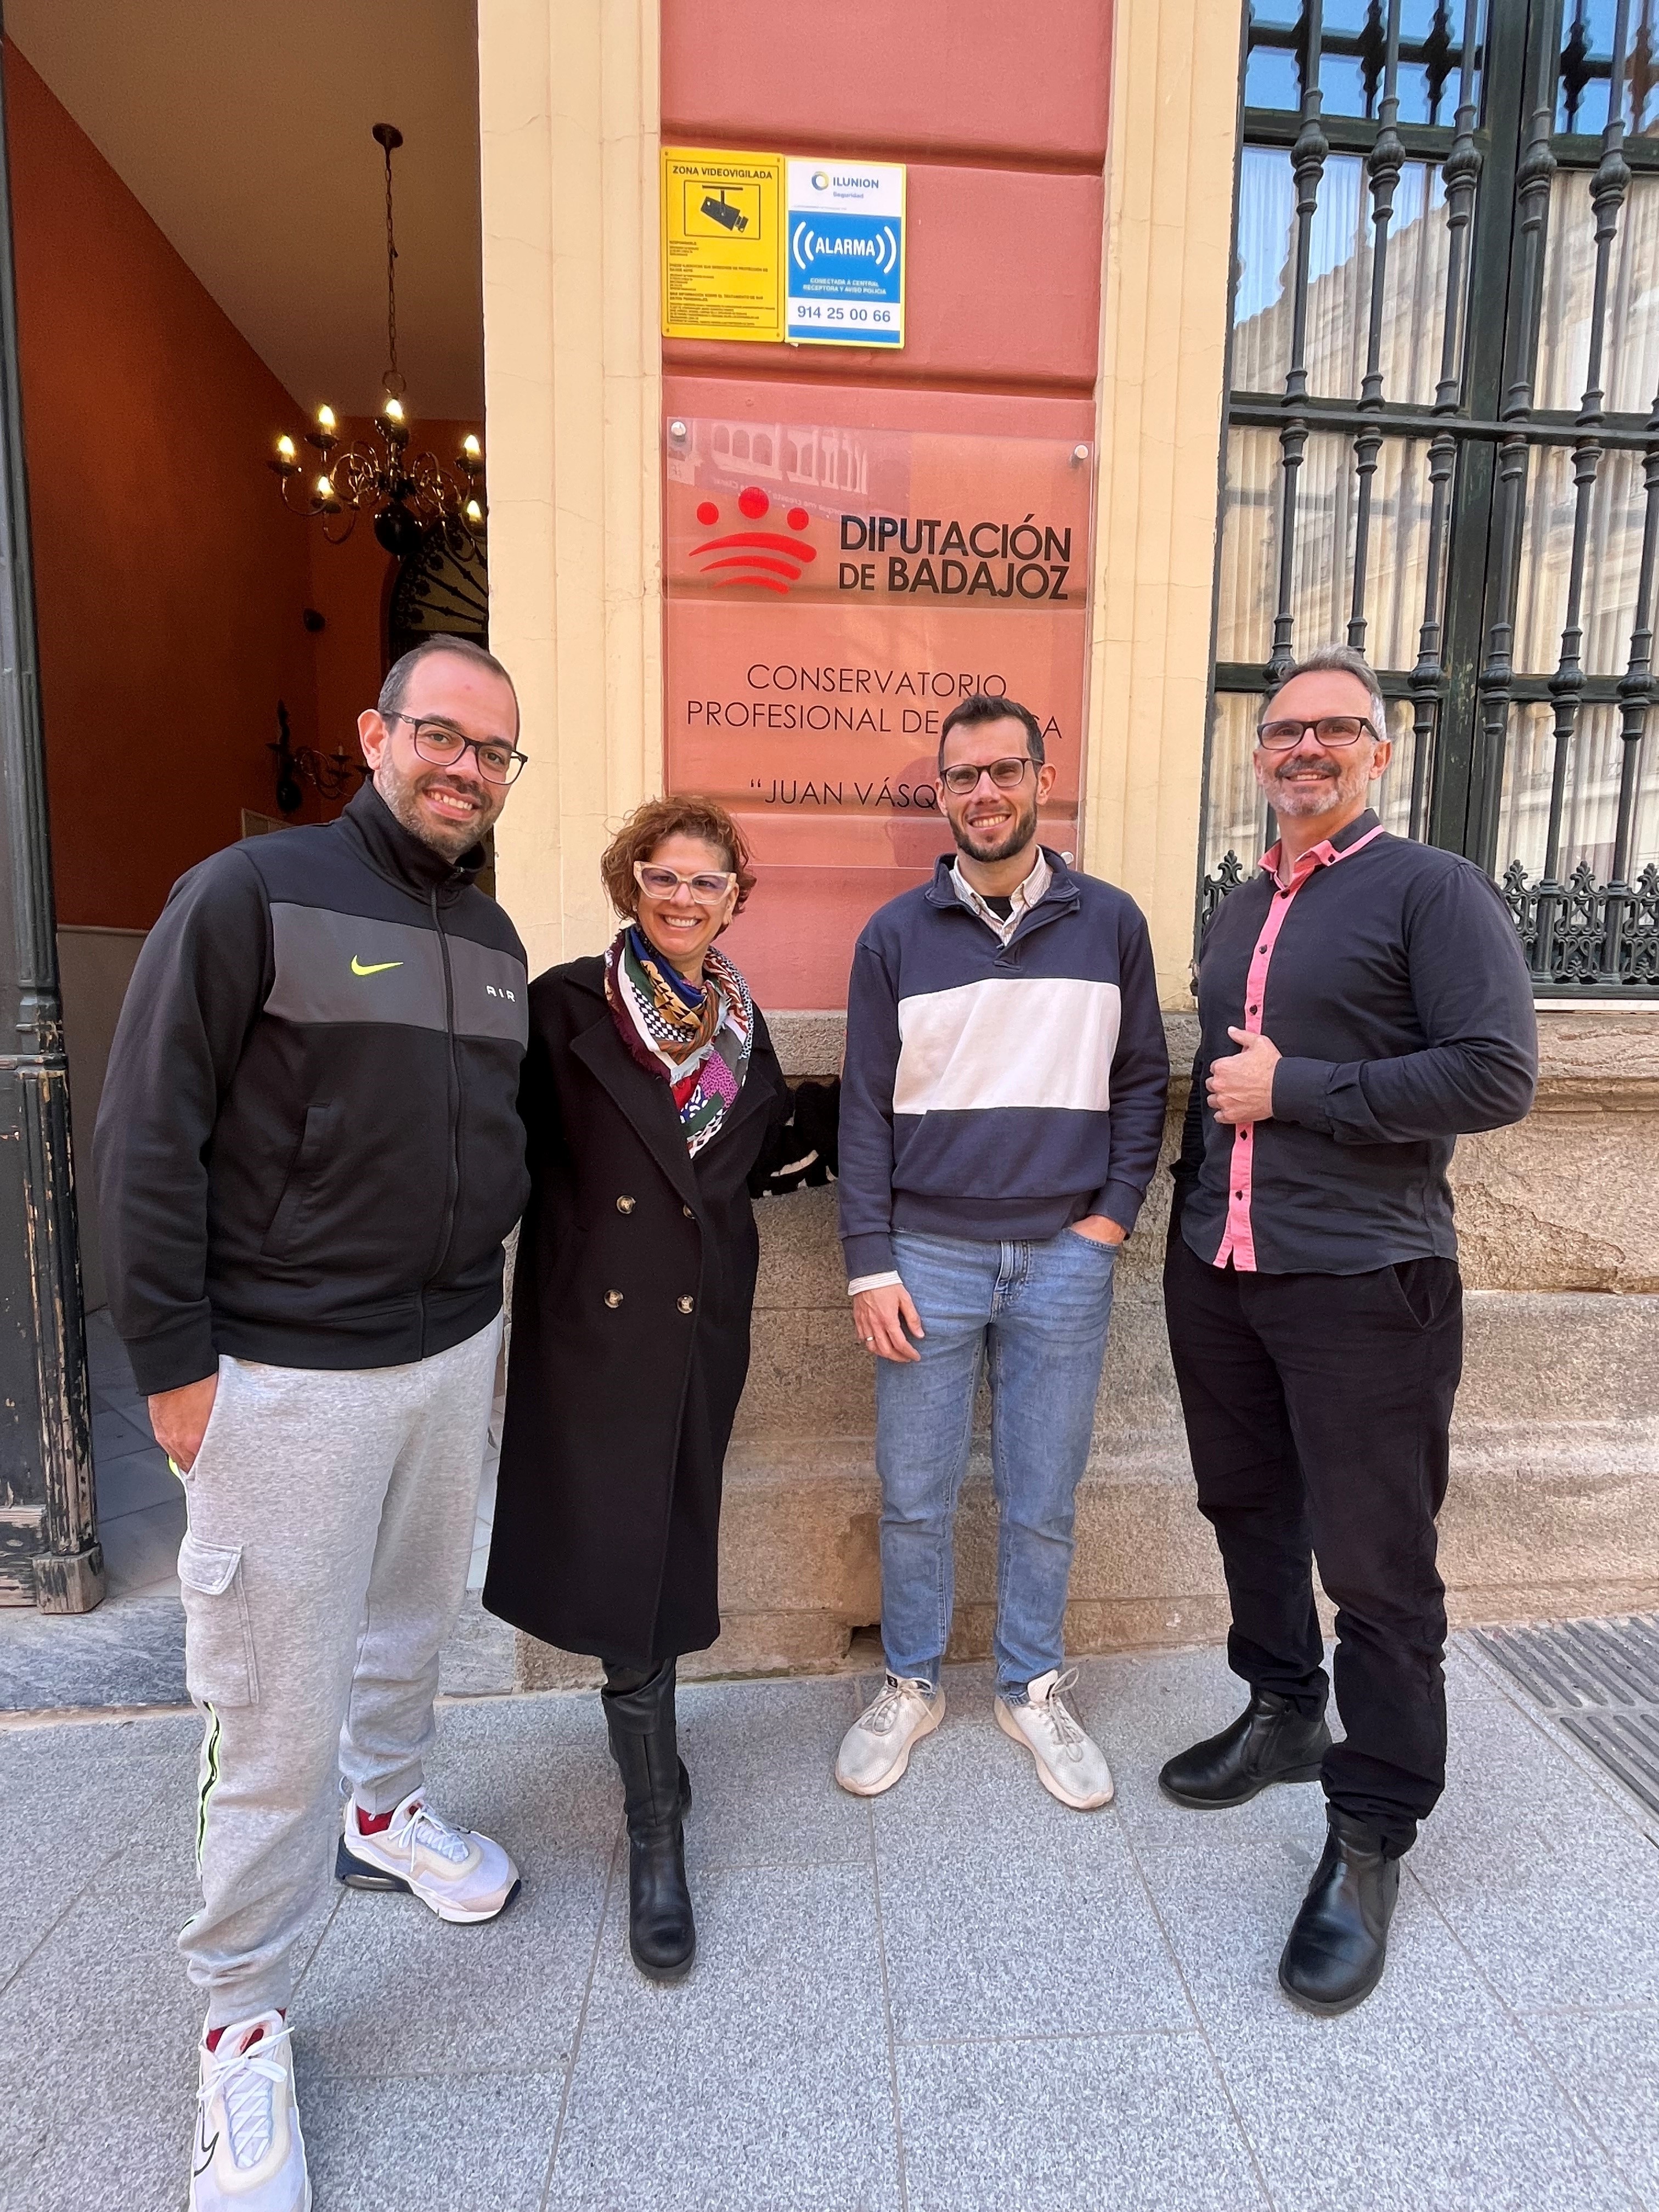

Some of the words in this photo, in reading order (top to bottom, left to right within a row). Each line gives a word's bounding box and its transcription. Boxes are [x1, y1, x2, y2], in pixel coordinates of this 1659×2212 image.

[672, 166, 699, 176] ZONA
[701, 167, 772, 179] VIDEOVIGILADA
[833, 177, 879, 188] ILUNION
[815, 236, 876, 256] ALARMA
[797, 305, 821, 319] 914
[827, 307, 844, 320] 25
[850, 308, 867, 321] 00
[873, 309, 891, 323] 66
[840, 514, 1071, 562] DIPUTACIÓN
[839, 563, 876, 591] DE
[888, 557, 1070, 600] BADAJOZ
[747, 664, 1007, 697] CONSERVATORIO
[687, 701, 891, 732] PROFESIONAL
[902, 709, 939, 734] DE
[854, 777, 936, 810] VÁSQ
[486, 985, 516, 1002] AIR
